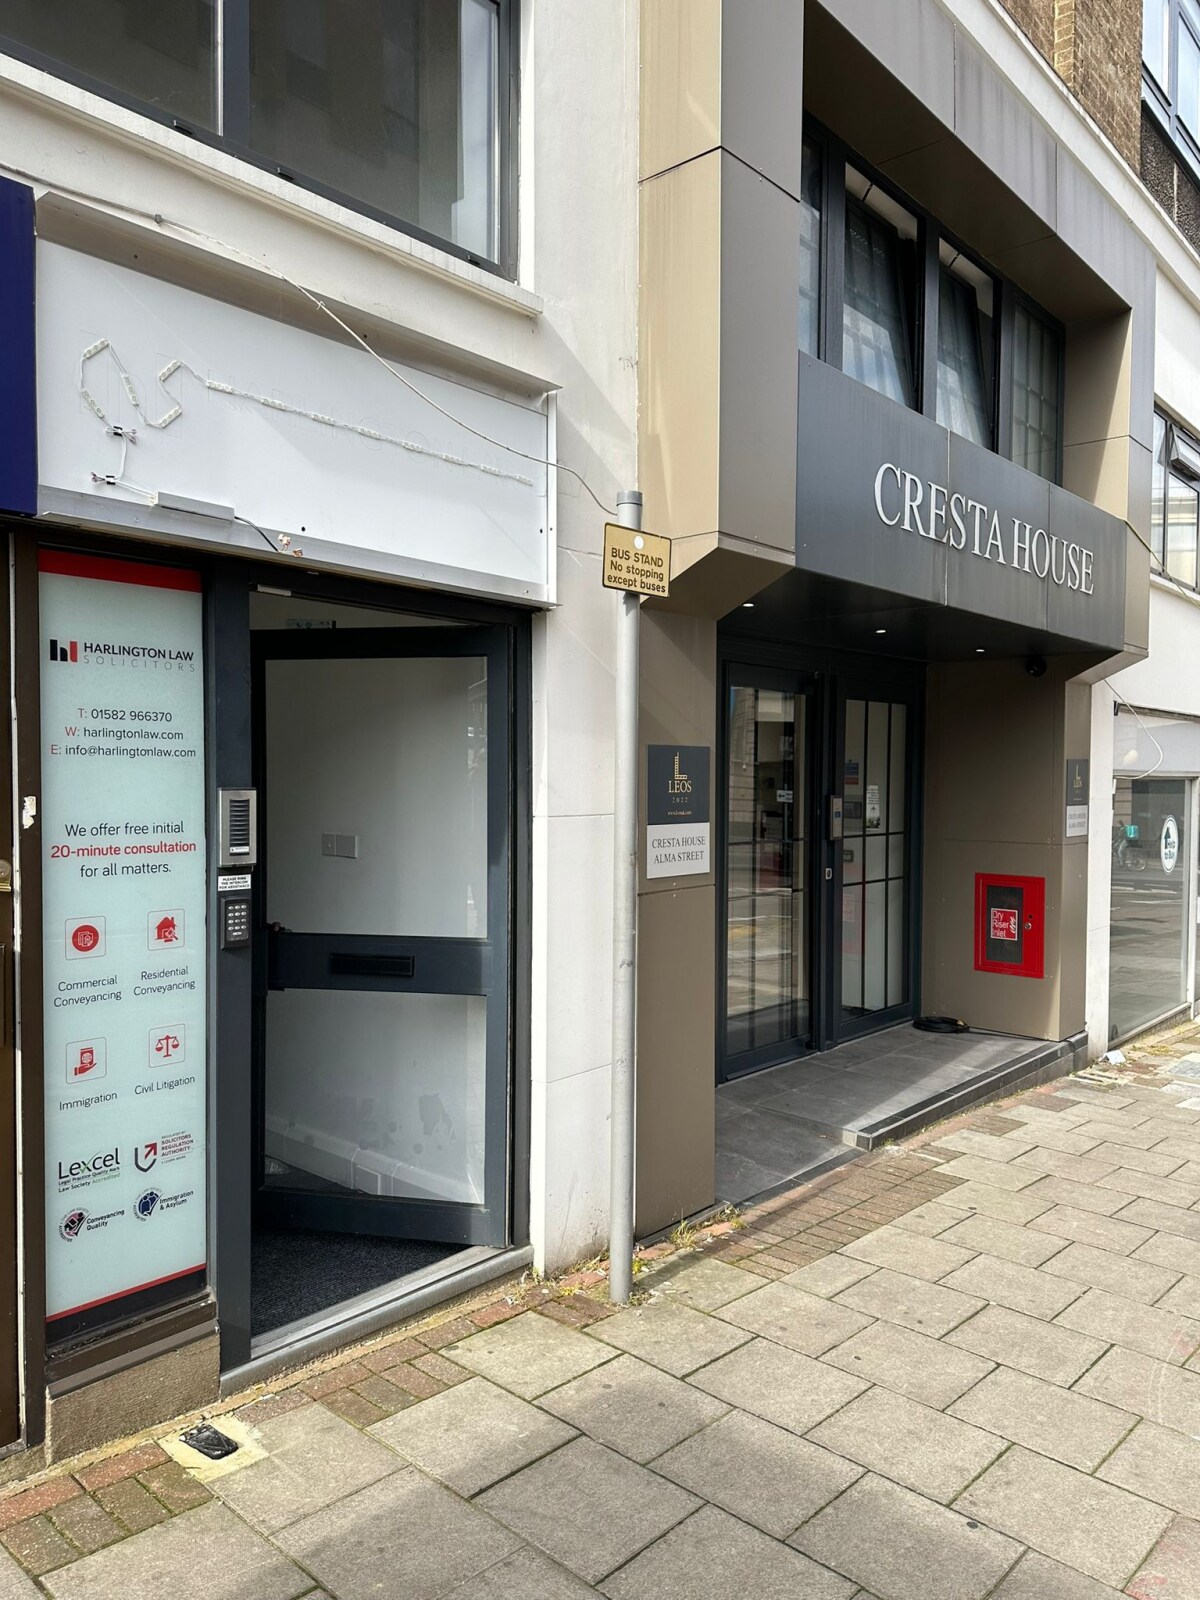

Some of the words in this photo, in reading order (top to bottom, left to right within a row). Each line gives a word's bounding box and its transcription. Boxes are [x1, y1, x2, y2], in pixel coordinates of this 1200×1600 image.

[874, 463, 1006, 565] CRESTA
[1010, 517, 1094, 595] HOUSE
[611, 547, 631, 560] BUS
[634, 552, 664, 567] STAND
[610, 560, 623, 571] No
[626, 565, 664, 582] stopping
[607, 574, 637, 587] except
[640, 579, 666, 593] buses
[84, 642, 166, 659] HARLINGTON
[169, 650, 194, 662] LAW
[84, 655, 195, 672] SOLICITORS
[78, 708, 88, 719] T:
[91, 708, 126, 720] 01582
[129, 710, 173, 722] 966370
[65, 726, 80, 737] W:
[83, 727, 184, 740] harlingtonlaw.com
[50, 744, 62, 755] E:
[65, 745, 196, 758] info@harlingtonlaw.com
[668, 780, 692, 793] LEOS
[65, 824, 87, 837] We
[90, 823, 121, 836] offer
[125, 822, 149, 835] free
[152, 820, 184, 834] initial
[51, 844, 121, 858] 20-minute
[124, 841, 197, 855] consultation
[652, 837, 681, 849] CRESTA
[682, 835, 706, 847] HOUSE
[654, 853, 677, 864] ALMA
[677, 850, 704, 862] STREET
[80, 864, 99, 877] for
[102, 863, 118, 876] all
[121, 862, 172, 875] matters.
[992, 911, 1004, 920] Dry
[992, 920, 1010, 929] Riser
[992, 929, 1007, 938] Inlet
[141, 966, 189, 980] Residential
[58, 975, 118, 992] Commercial
[134, 980, 196, 996] Conveyancing
[54, 991, 122, 1007] Conveyancing
[134, 1083, 154, 1095] Civil
[156, 1075, 196, 1091] Litigation
[59, 1091, 118, 1111] Immigration
[161, 1134, 192, 1146] SOLICITORS
[161, 1139, 194, 1151] REGULATION
[161, 1146, 191, 1157] AUTHORITY
[59, 1147, 120, 1179] Lexcel
[71, 1181, 91, 1190] Society
[160, 1190, 194, 1205] Immigration
[166, 1198, 187, 1210] Asylum
[86, 1209, 125, 1225] Conveyancing
[86, 1220, 109, 1231] Quality
